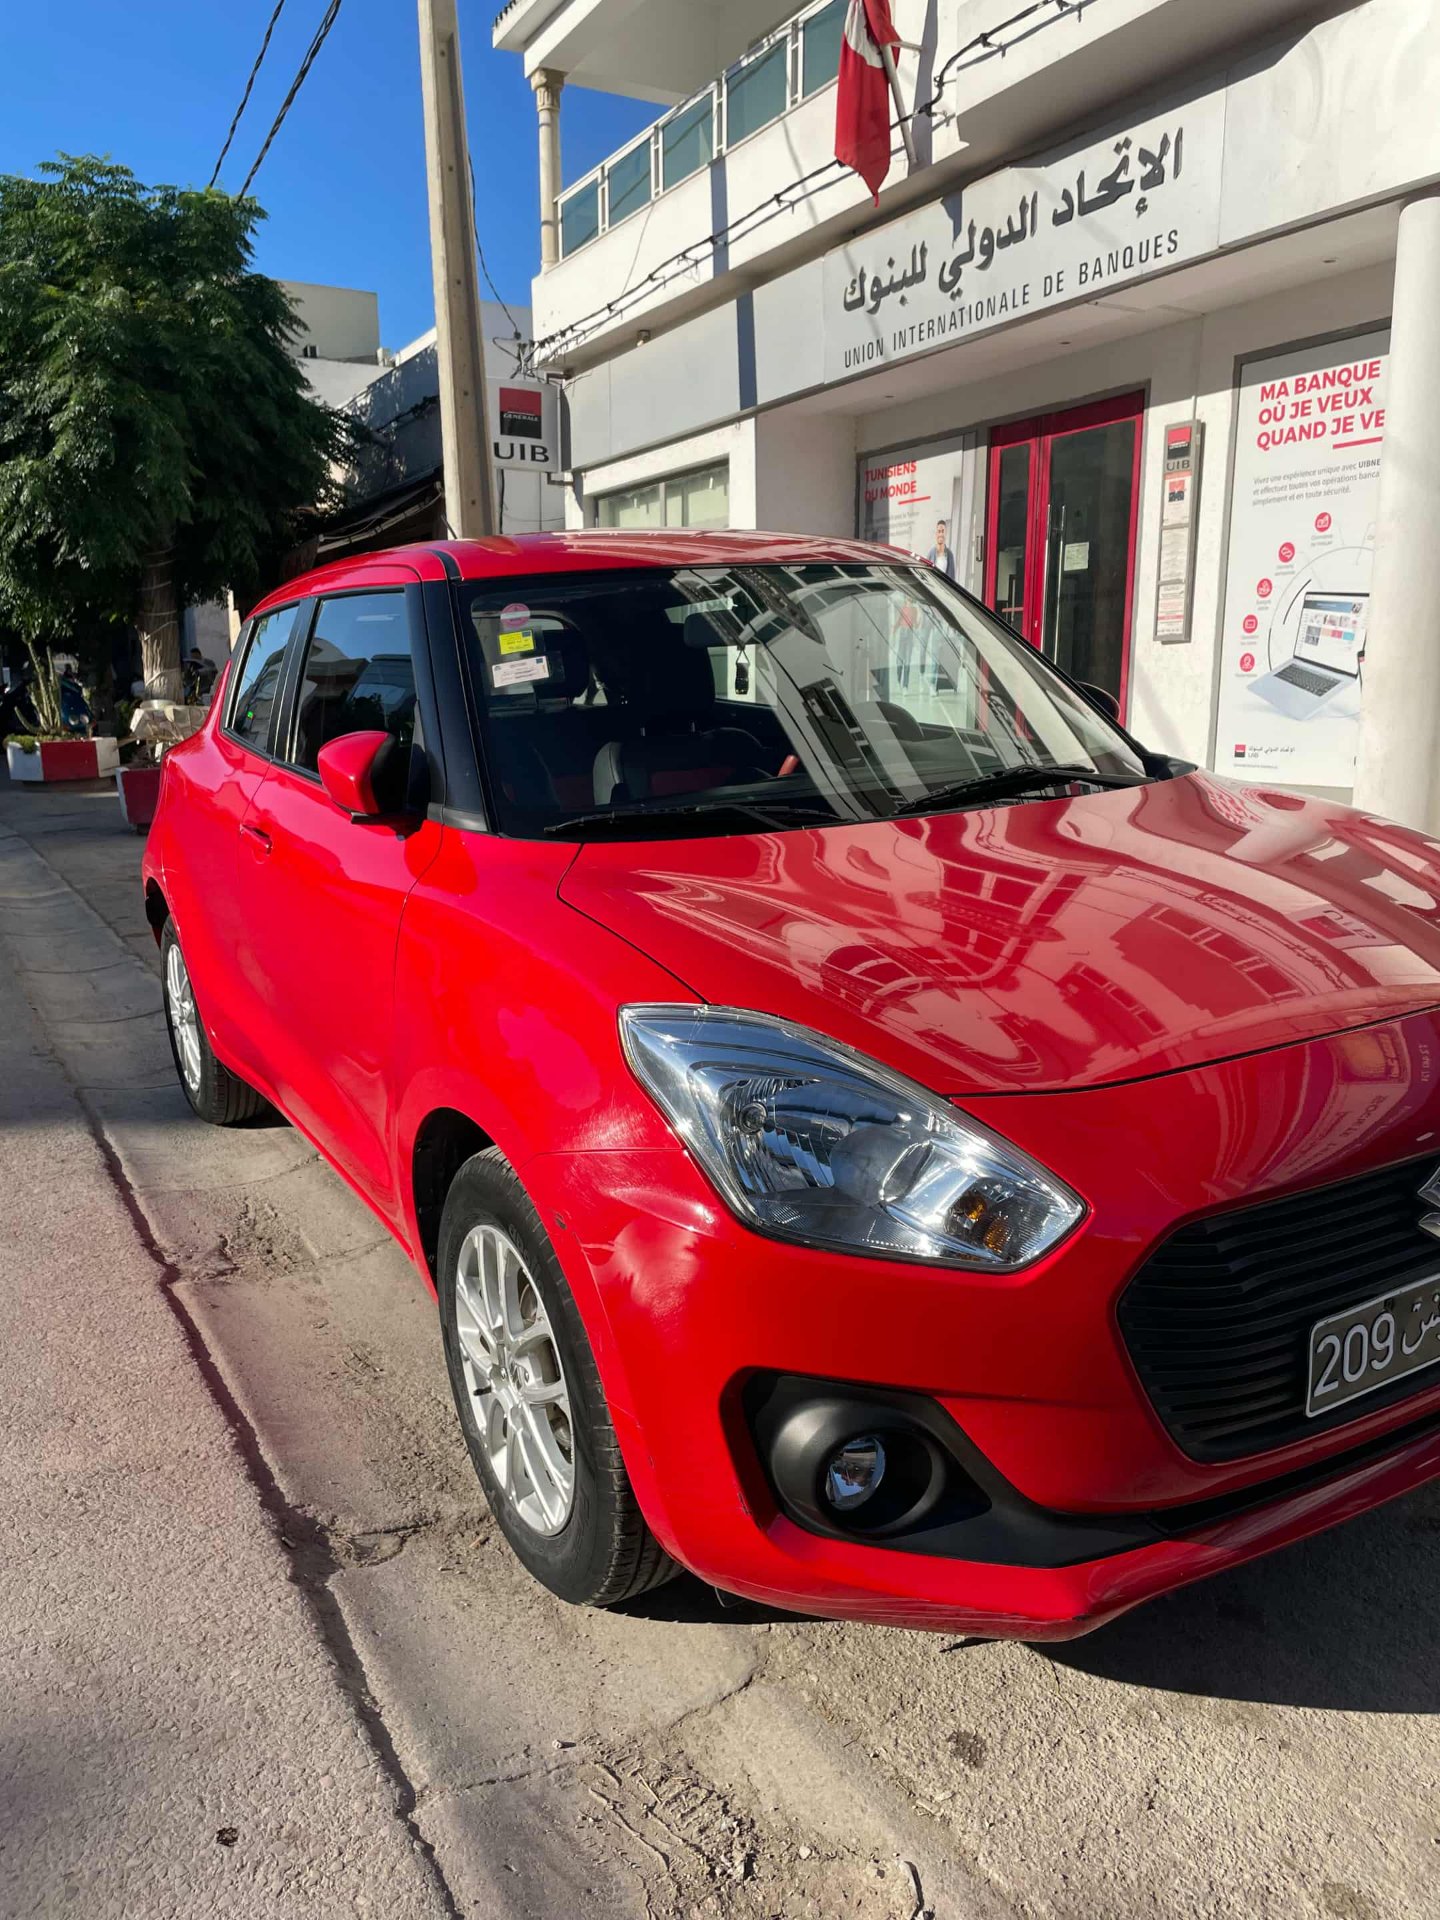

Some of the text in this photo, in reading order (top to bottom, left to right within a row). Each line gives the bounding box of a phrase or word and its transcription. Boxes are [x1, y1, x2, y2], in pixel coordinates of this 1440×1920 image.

[843, 127, 1183, 315] الإتحاد الدولي للبنوك
[844, 229, 1179, 368] UNION INTERNATIONALE DE BANQUES
[1260, 360, 1381, 402] MA BANQUE
[1258, 386, 1374, 425] OÙ JE VEUX
[1256, 409, 1386, 451] QUAND JE VE
[493, 442, 550, 463] UIB
[865, 460, 918, 483] TUNISIENS
[1166, 460, 1190, 472] UIB
[864, 480, 917, 503] DU MONDE
[1313, 1312, 1396, 1398] 209
